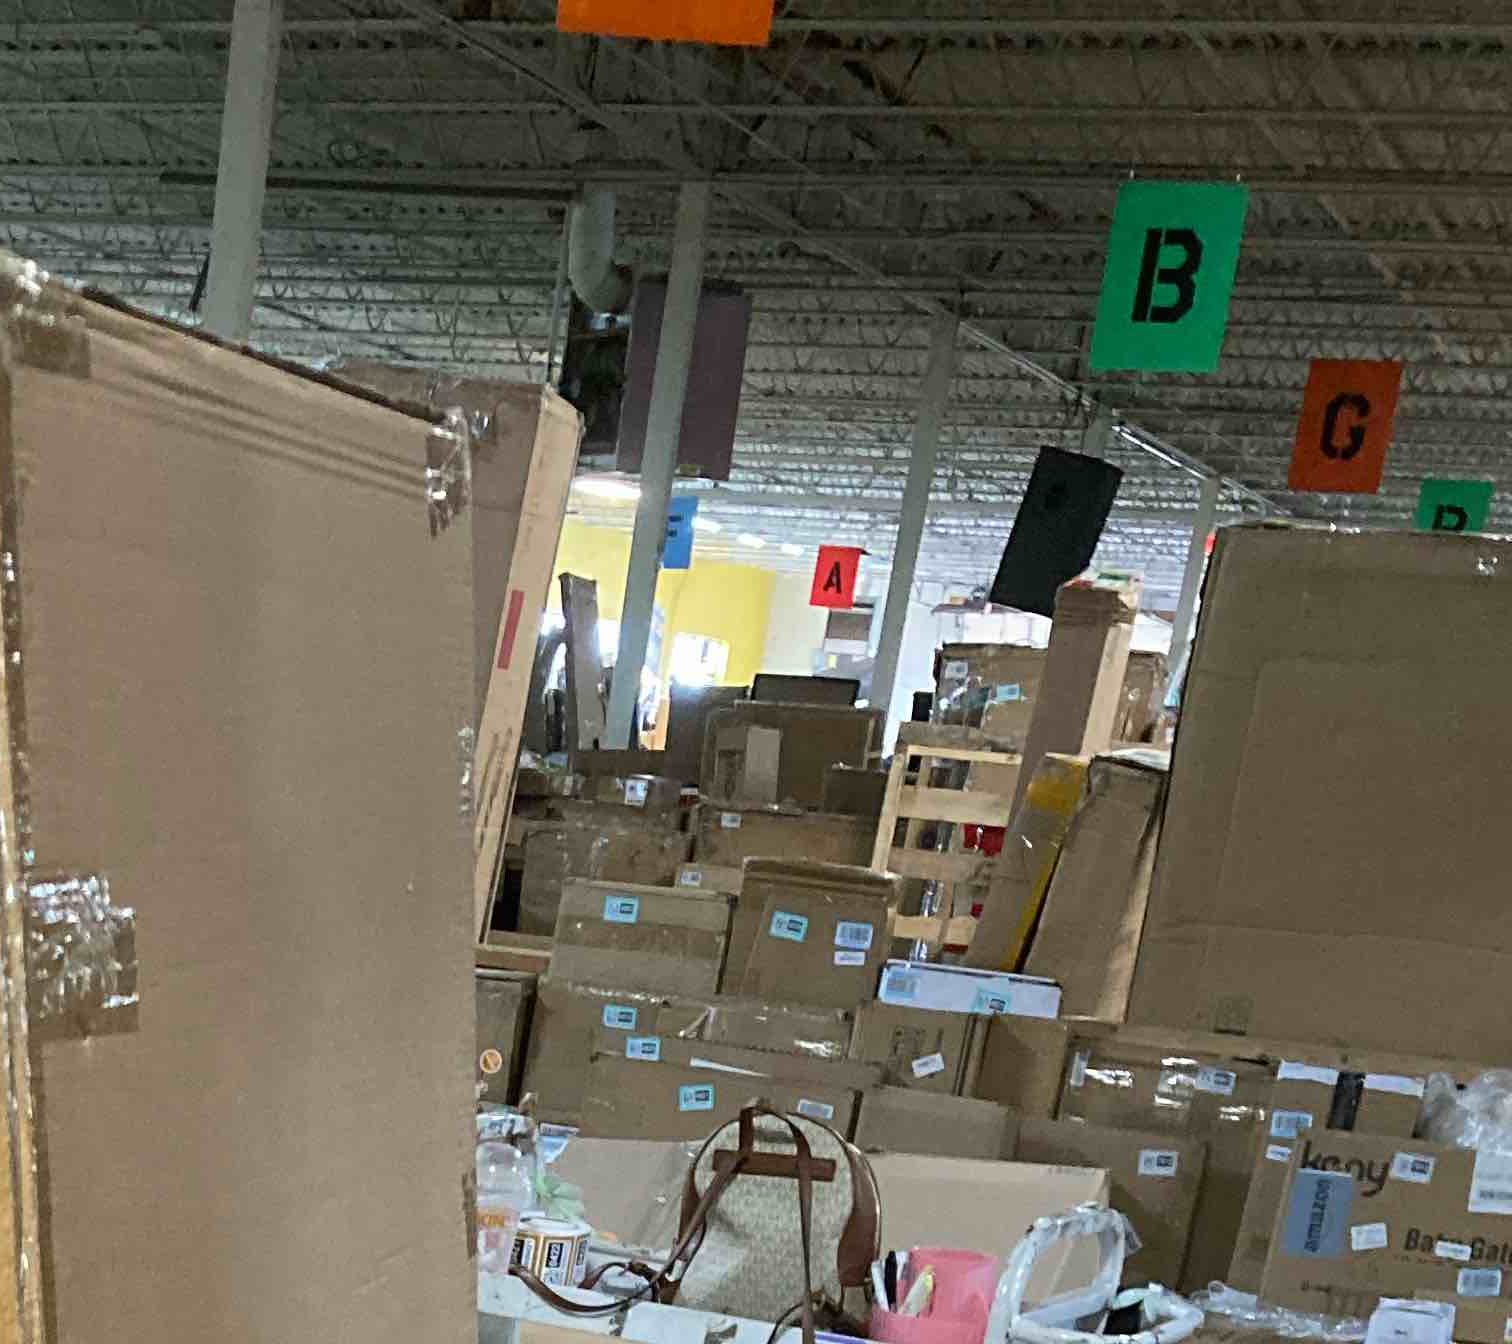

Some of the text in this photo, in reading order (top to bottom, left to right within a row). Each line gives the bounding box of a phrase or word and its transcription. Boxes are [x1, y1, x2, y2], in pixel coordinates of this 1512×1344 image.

[1132, 227, 1203, 323] B
[1320, 392, 1371, 460] G
[822, 561, 842, 594] A
